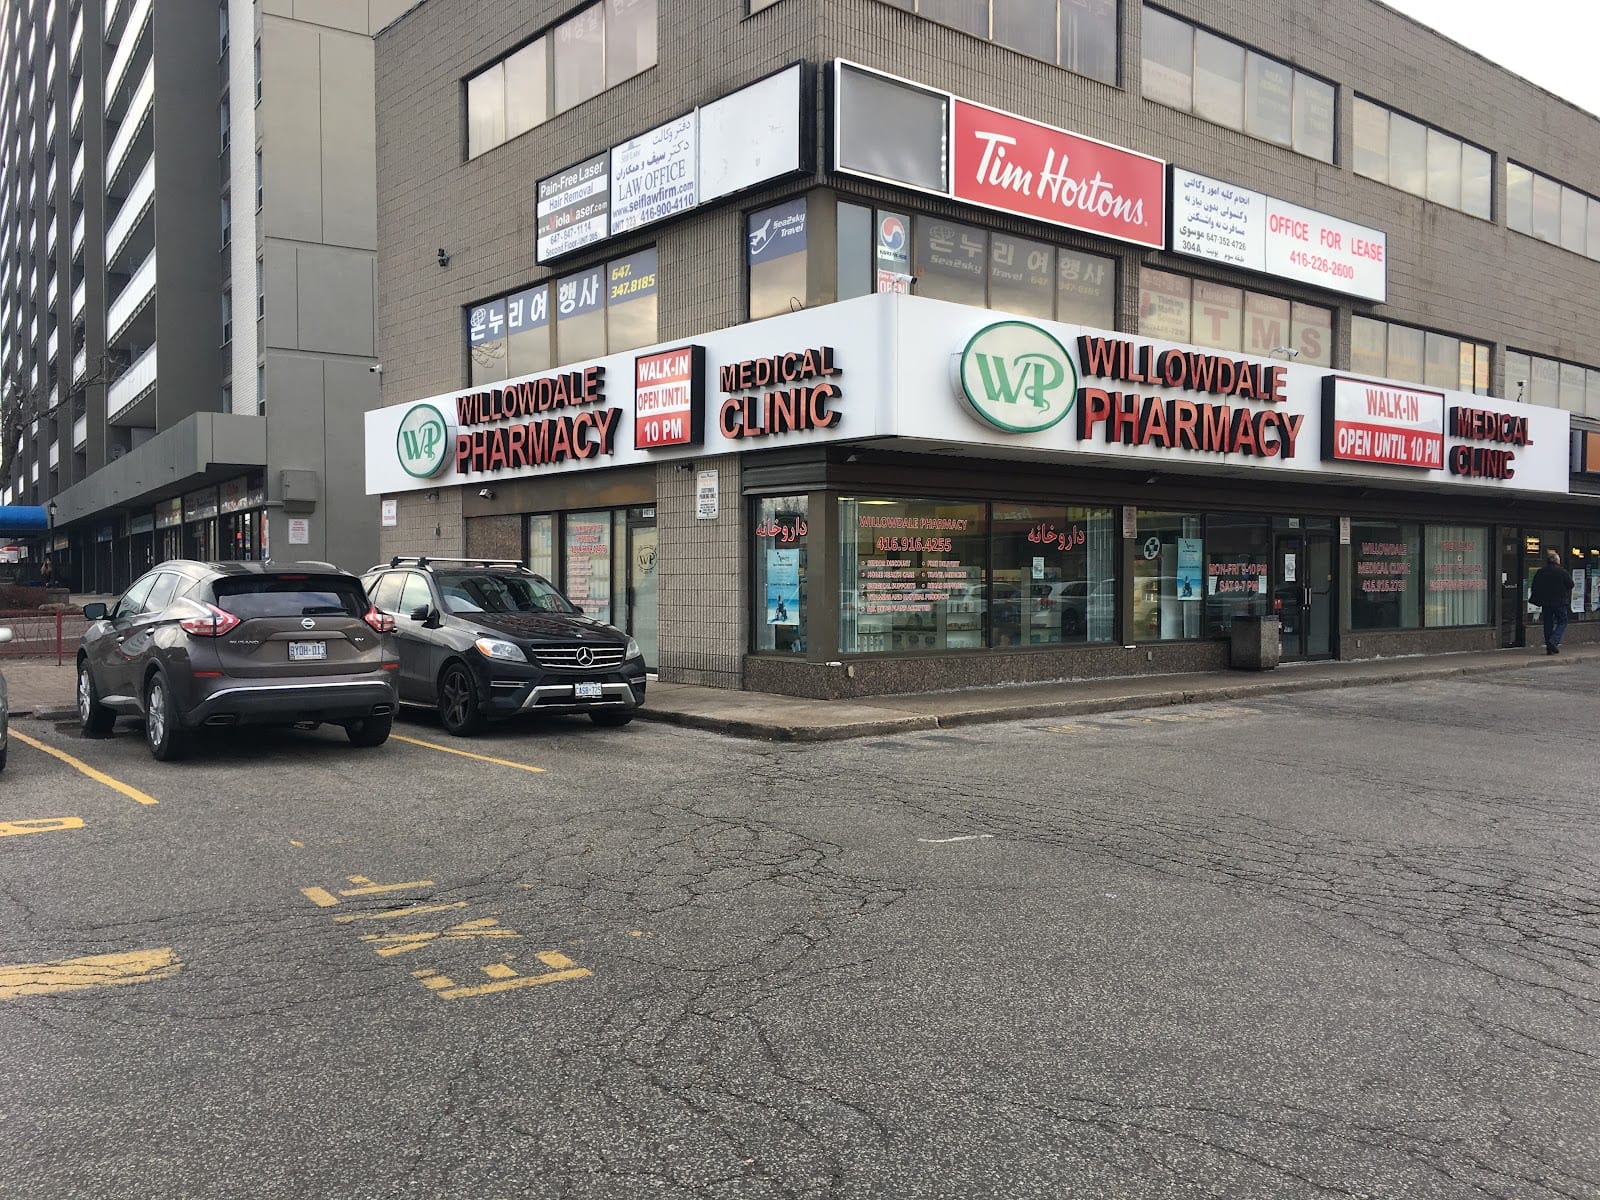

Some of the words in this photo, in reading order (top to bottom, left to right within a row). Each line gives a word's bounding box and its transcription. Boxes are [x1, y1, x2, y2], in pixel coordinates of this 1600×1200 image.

[541, 173, 578, 198] Pain-Free
[580, 161, 604, 181] Laser
[618, 175, 643, 202] LAW
[644, 159, 686, 191] OFFICE
[974, 130, 1033, 196] Tim
[1037, 147, 1145, 225] Hortons
[549, 198, 562, 211] Hair
[564, 182, 593, 204] Removal
[640, 193, 694, 222] 416-900-4110
[773, 212, 806, 230] Sea2sky
[781, 222, 804, 238] Travel
[1269, 213, 1309, 242] OFFICE
[1320, 228, 1342, 251] FOR
[1351, 236, 1383, 262] LEASE
[929, 254, 982, 275] Sea2sky
[991, 267, 1024, 282] Travel
[1290, 250, 1354, 280] 416-226-2600
[611, 273, 656, 299] 347.8185
[639, 354, 689, 382] WALK-IN
[720, 346, 839, 393] MEDICAL
[1078, 335, 1288, 402] WILLOWDALE
[456, 366, 603, 427] WILLOWDALE
[637, 391, 660, 411] OPEN
[661, 386, 689, 407] UNTIL
[720, 383, 841, 439] CLINIC
[1366, 388, 1419, 422] WALK-IN
[644, 420, 659, 443] 10
[662, 417, 682, 441] PM
[1078, 388, 1304, 459] PHARMACY
[1451, 406, 1533, 446] MEDICAL
[456, 408, 620, 474] PHARMACY
[1338, 427, 1371, 456] OPEN
[1374, 433, 1407, 461] UNTIL
[1410, 436, 1423, 463] 10
[1425, 439, 1440, 465] PM
[1451, 445, 1515, 480] CLINIC
[756, 517, 808, 543] داروخانه
[858, 516, 919, 529] WILLOWDALE
[920, 518, 967, 531] PHARMACY
[1027, 523, 1086, 550] داروخانه
[876, 536, 952, 552] 416.916.4255
[1208, 563, 1239, 575] MON-FRI
